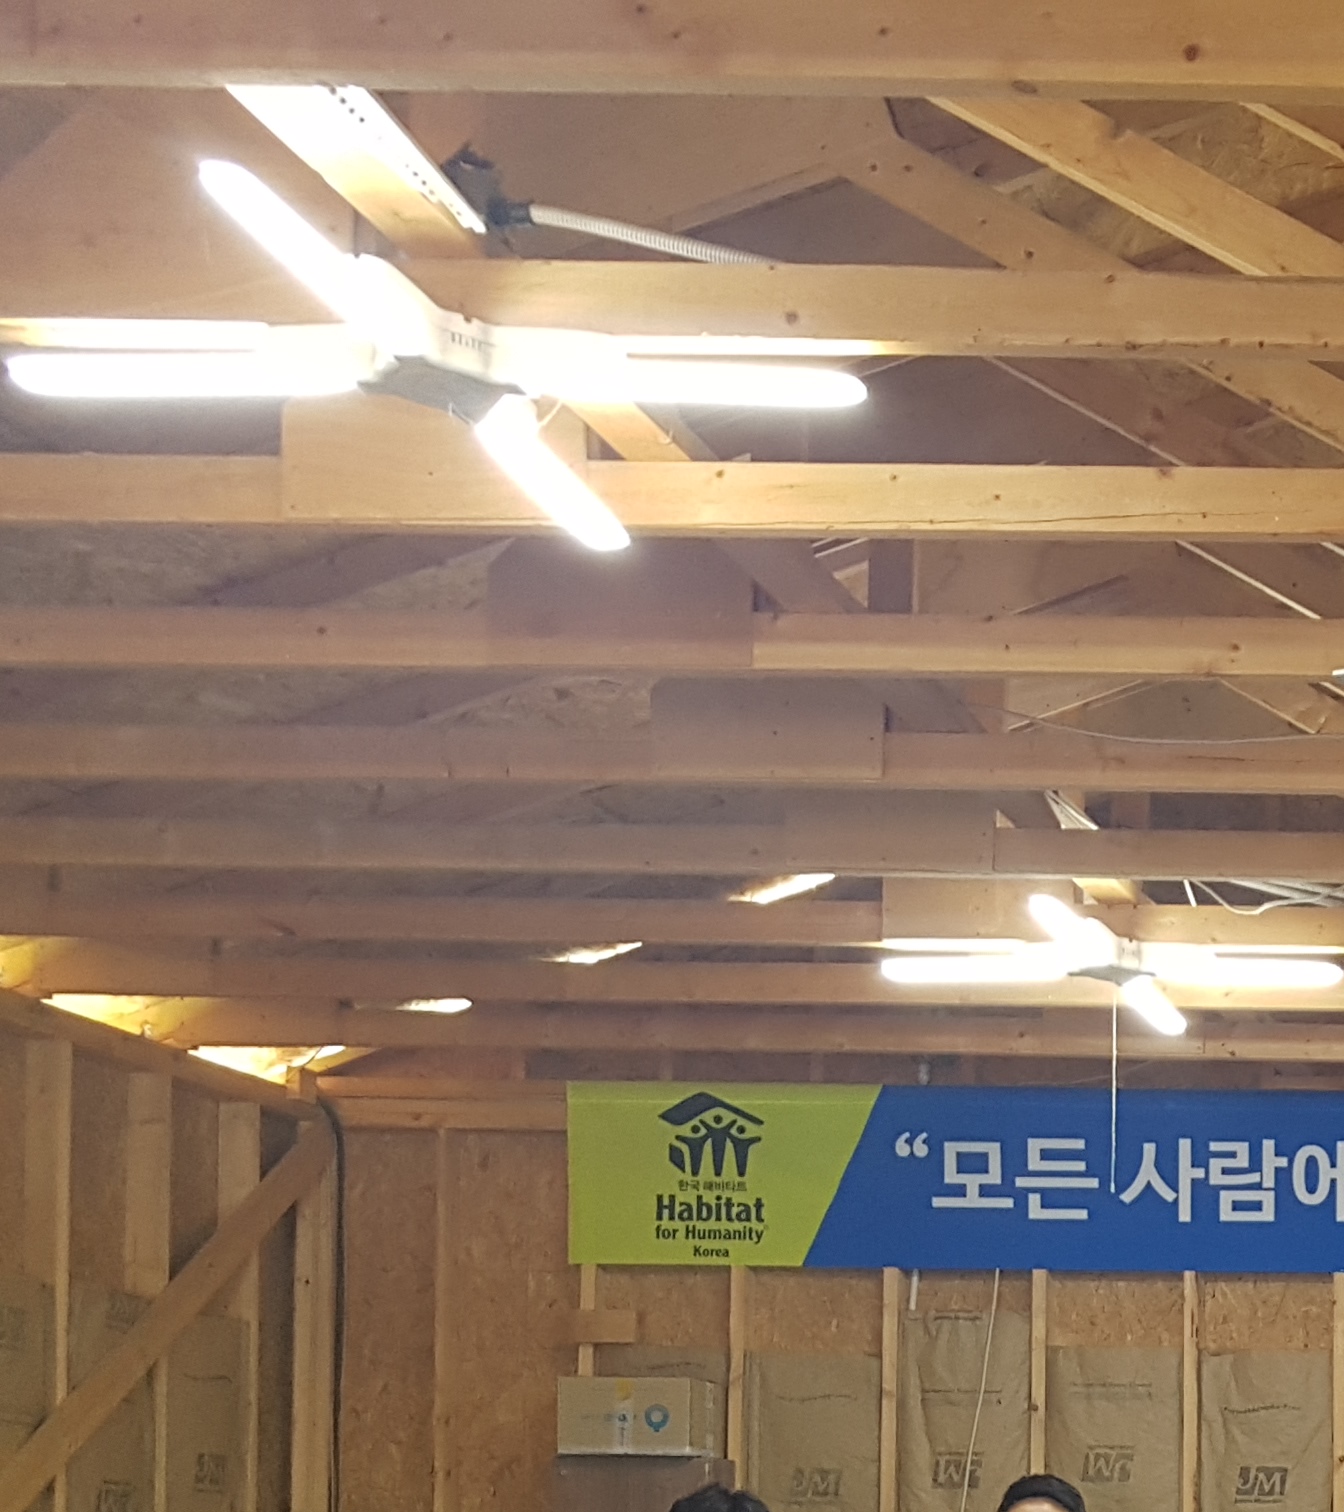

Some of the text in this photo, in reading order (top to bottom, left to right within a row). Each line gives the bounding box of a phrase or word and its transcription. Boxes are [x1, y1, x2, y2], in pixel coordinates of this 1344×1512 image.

[656, 1194, 765, 1222] Habitat
[655, 1224, 764, 1244] for Humanity
[693, 1245, 730, 1257] Korea
